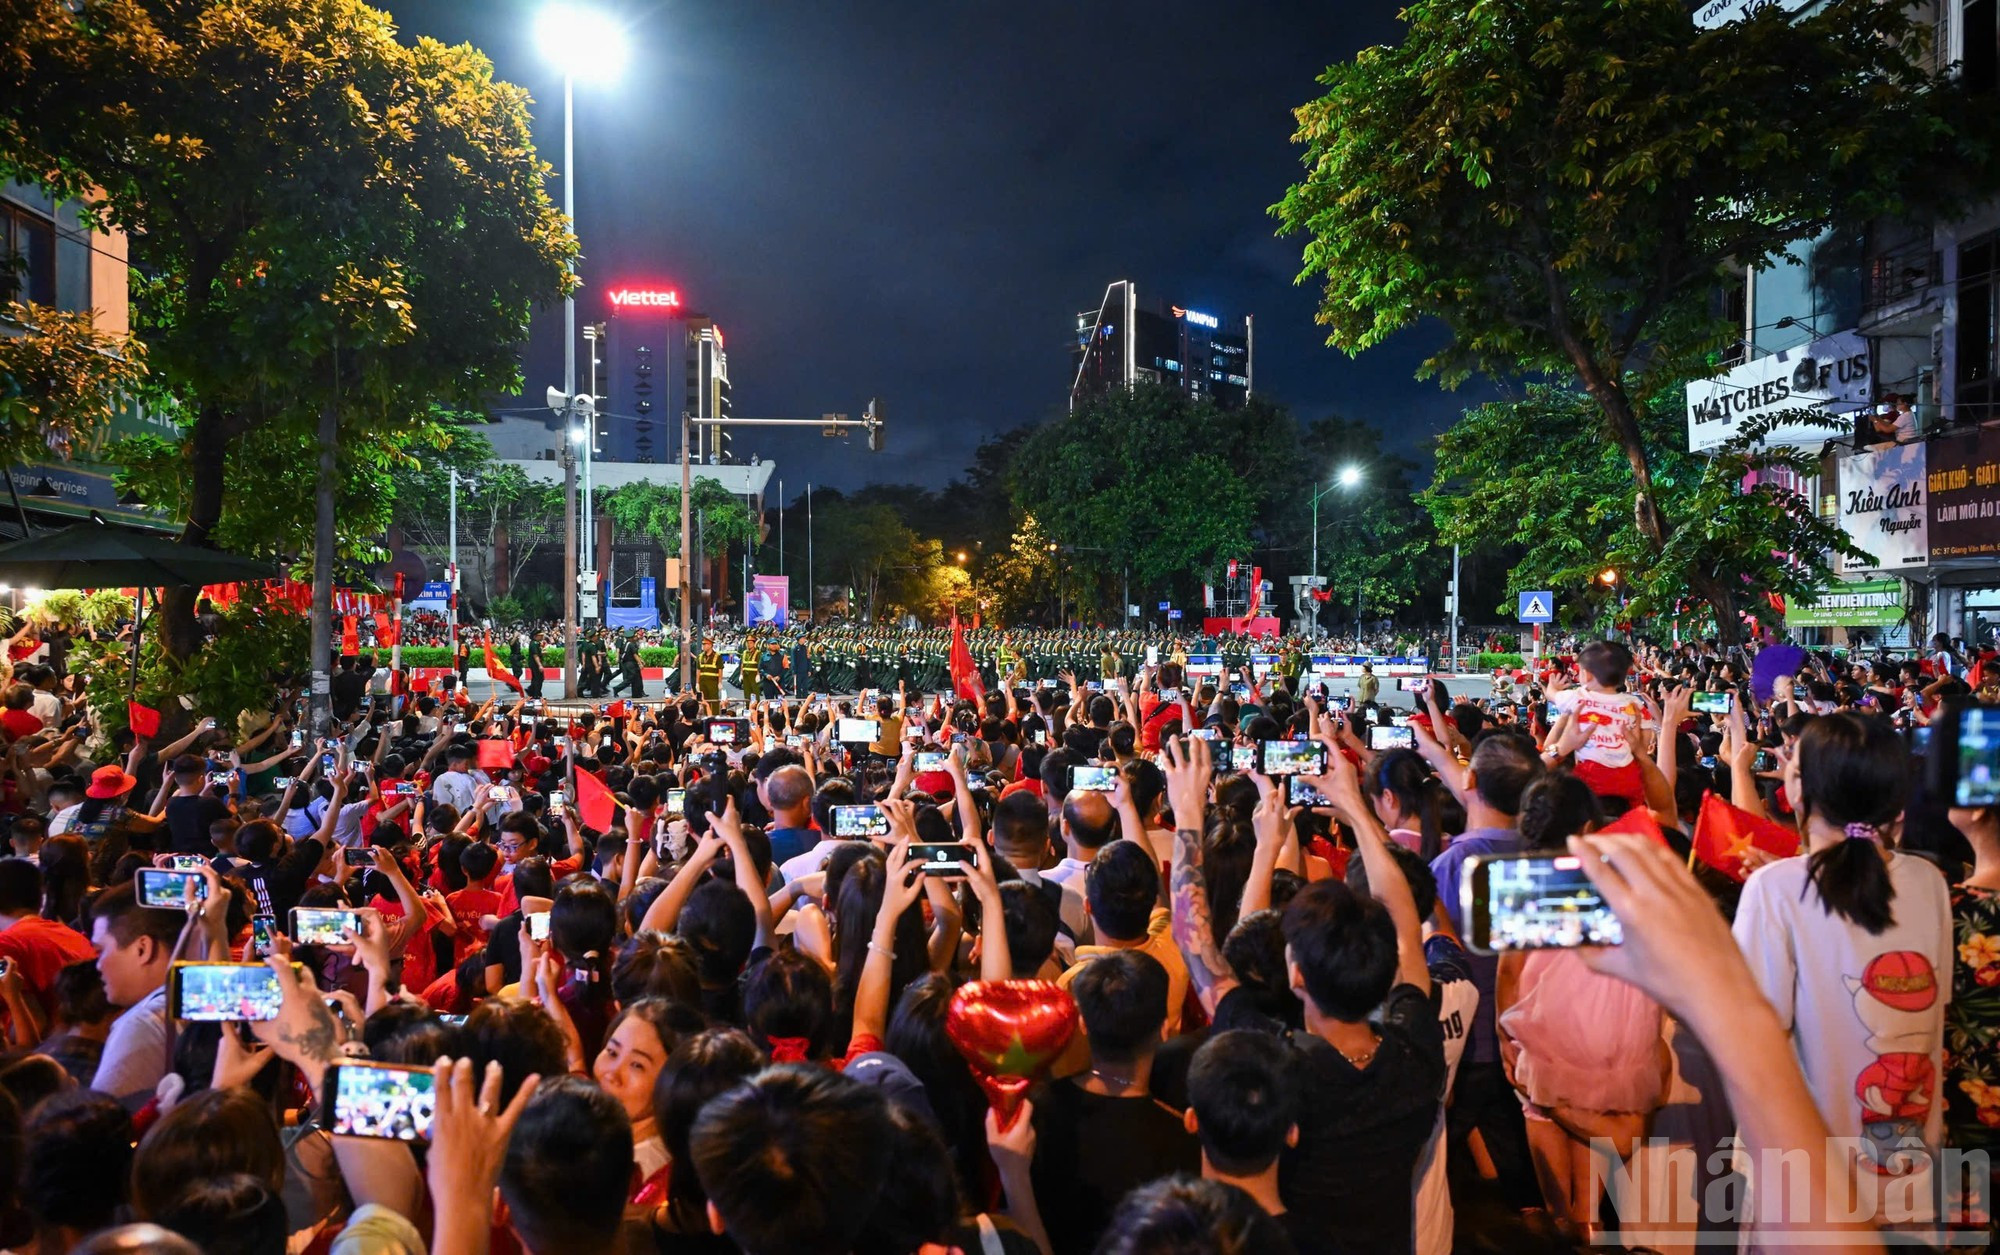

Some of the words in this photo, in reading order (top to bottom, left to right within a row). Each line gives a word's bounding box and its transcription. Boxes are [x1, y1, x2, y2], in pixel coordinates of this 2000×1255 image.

[609, 289, 679, 306] viettel
[1692, 376, 1790, 426] WATCHES
[1791, 356, 1832, 393] OF
[1837, 354, 1868, 384] US
[46, 476, 88, 496] Services
[1928, 468, 1947, 495] GIẶT
[1976, 461, 1997, 489] GIẶT
[1845, 486, 1883, 515] Kiều
[1886, 481, 1921, 509] Anh
[1937, 503, 1957, 523] LÀM
[1959, 499, 1978, 520] MỚI
[1980, 498, 1994, 518] ÁO
[1879, 513, 1921, 535] Nguyễn
[435, 589, 448, 598] MÃ
